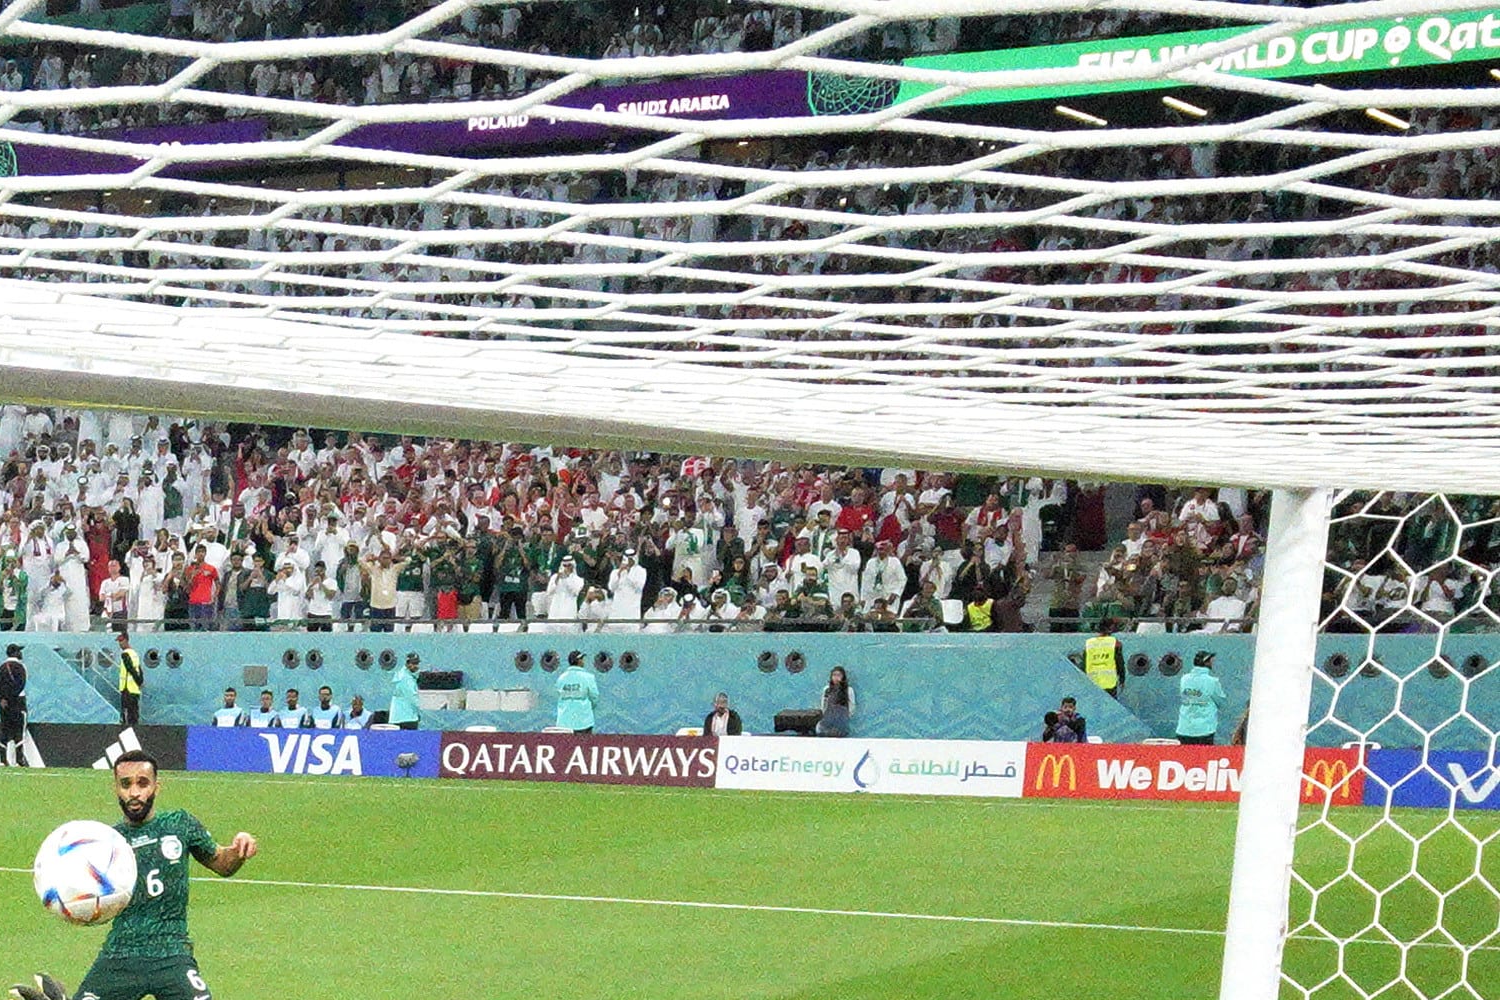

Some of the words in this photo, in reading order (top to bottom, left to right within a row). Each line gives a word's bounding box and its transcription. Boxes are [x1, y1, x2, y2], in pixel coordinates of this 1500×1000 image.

[1156, 36, 1296, 73] WRLD
[1302, 28, 1378, 64] CUP
[1417, 13, 1500, 60] Qat
[468, 114, 529, 131] POLAND
[617, 99, 667, 116] SAUDI
[669, 94, 731, 114] ARABIA
[258, 733, 363, 776] VISA
[442, 743, 555, 775] QATAR
[565, 746, 716, 777] AIRWAYS
[725, 755, 844, 777] QatarEnergy
[1097, 759, 1151, 791] We
[146, 868, 164, 897] 6
[186, 969, 206, 991] 6
